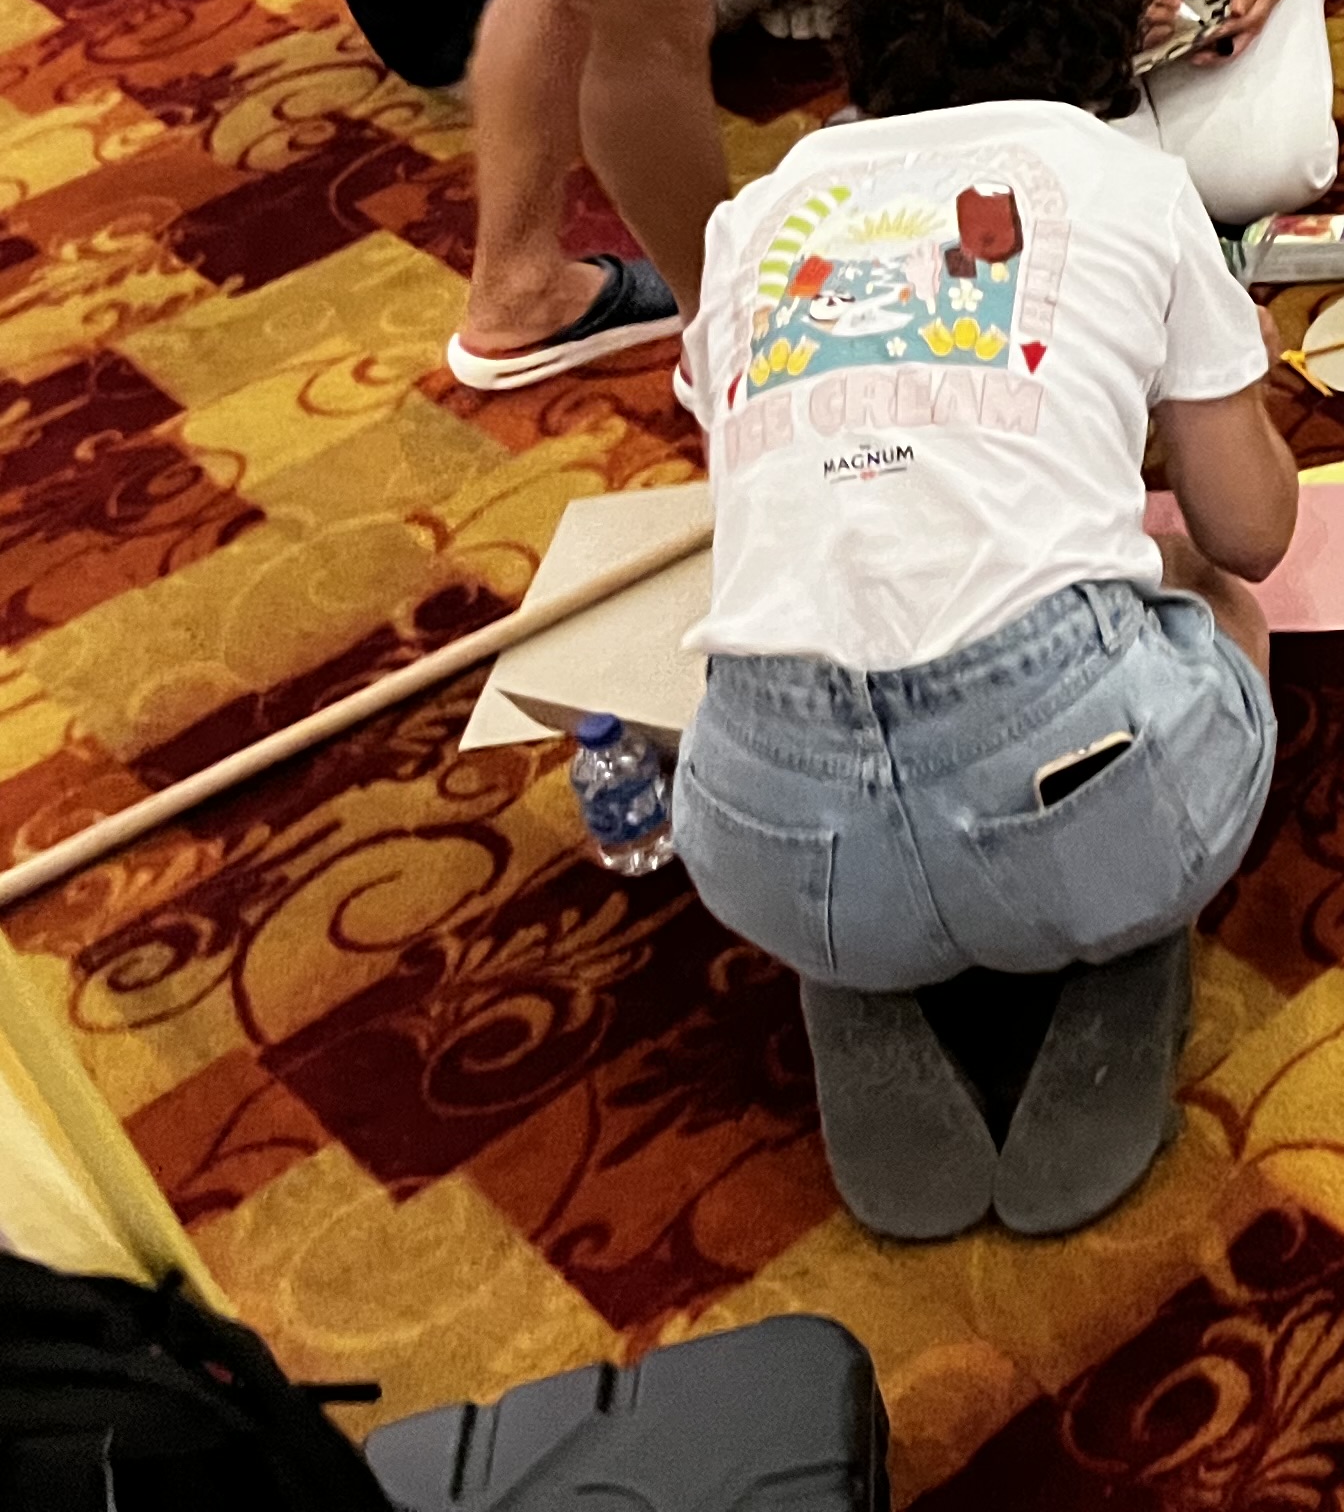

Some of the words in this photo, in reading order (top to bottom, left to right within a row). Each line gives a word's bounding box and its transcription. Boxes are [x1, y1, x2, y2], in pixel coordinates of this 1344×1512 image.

[724, 391, 793, 473] ICE
[809, 369, 1043, 435] CREAM
[823, 444, 914, 479] MAGNUM
